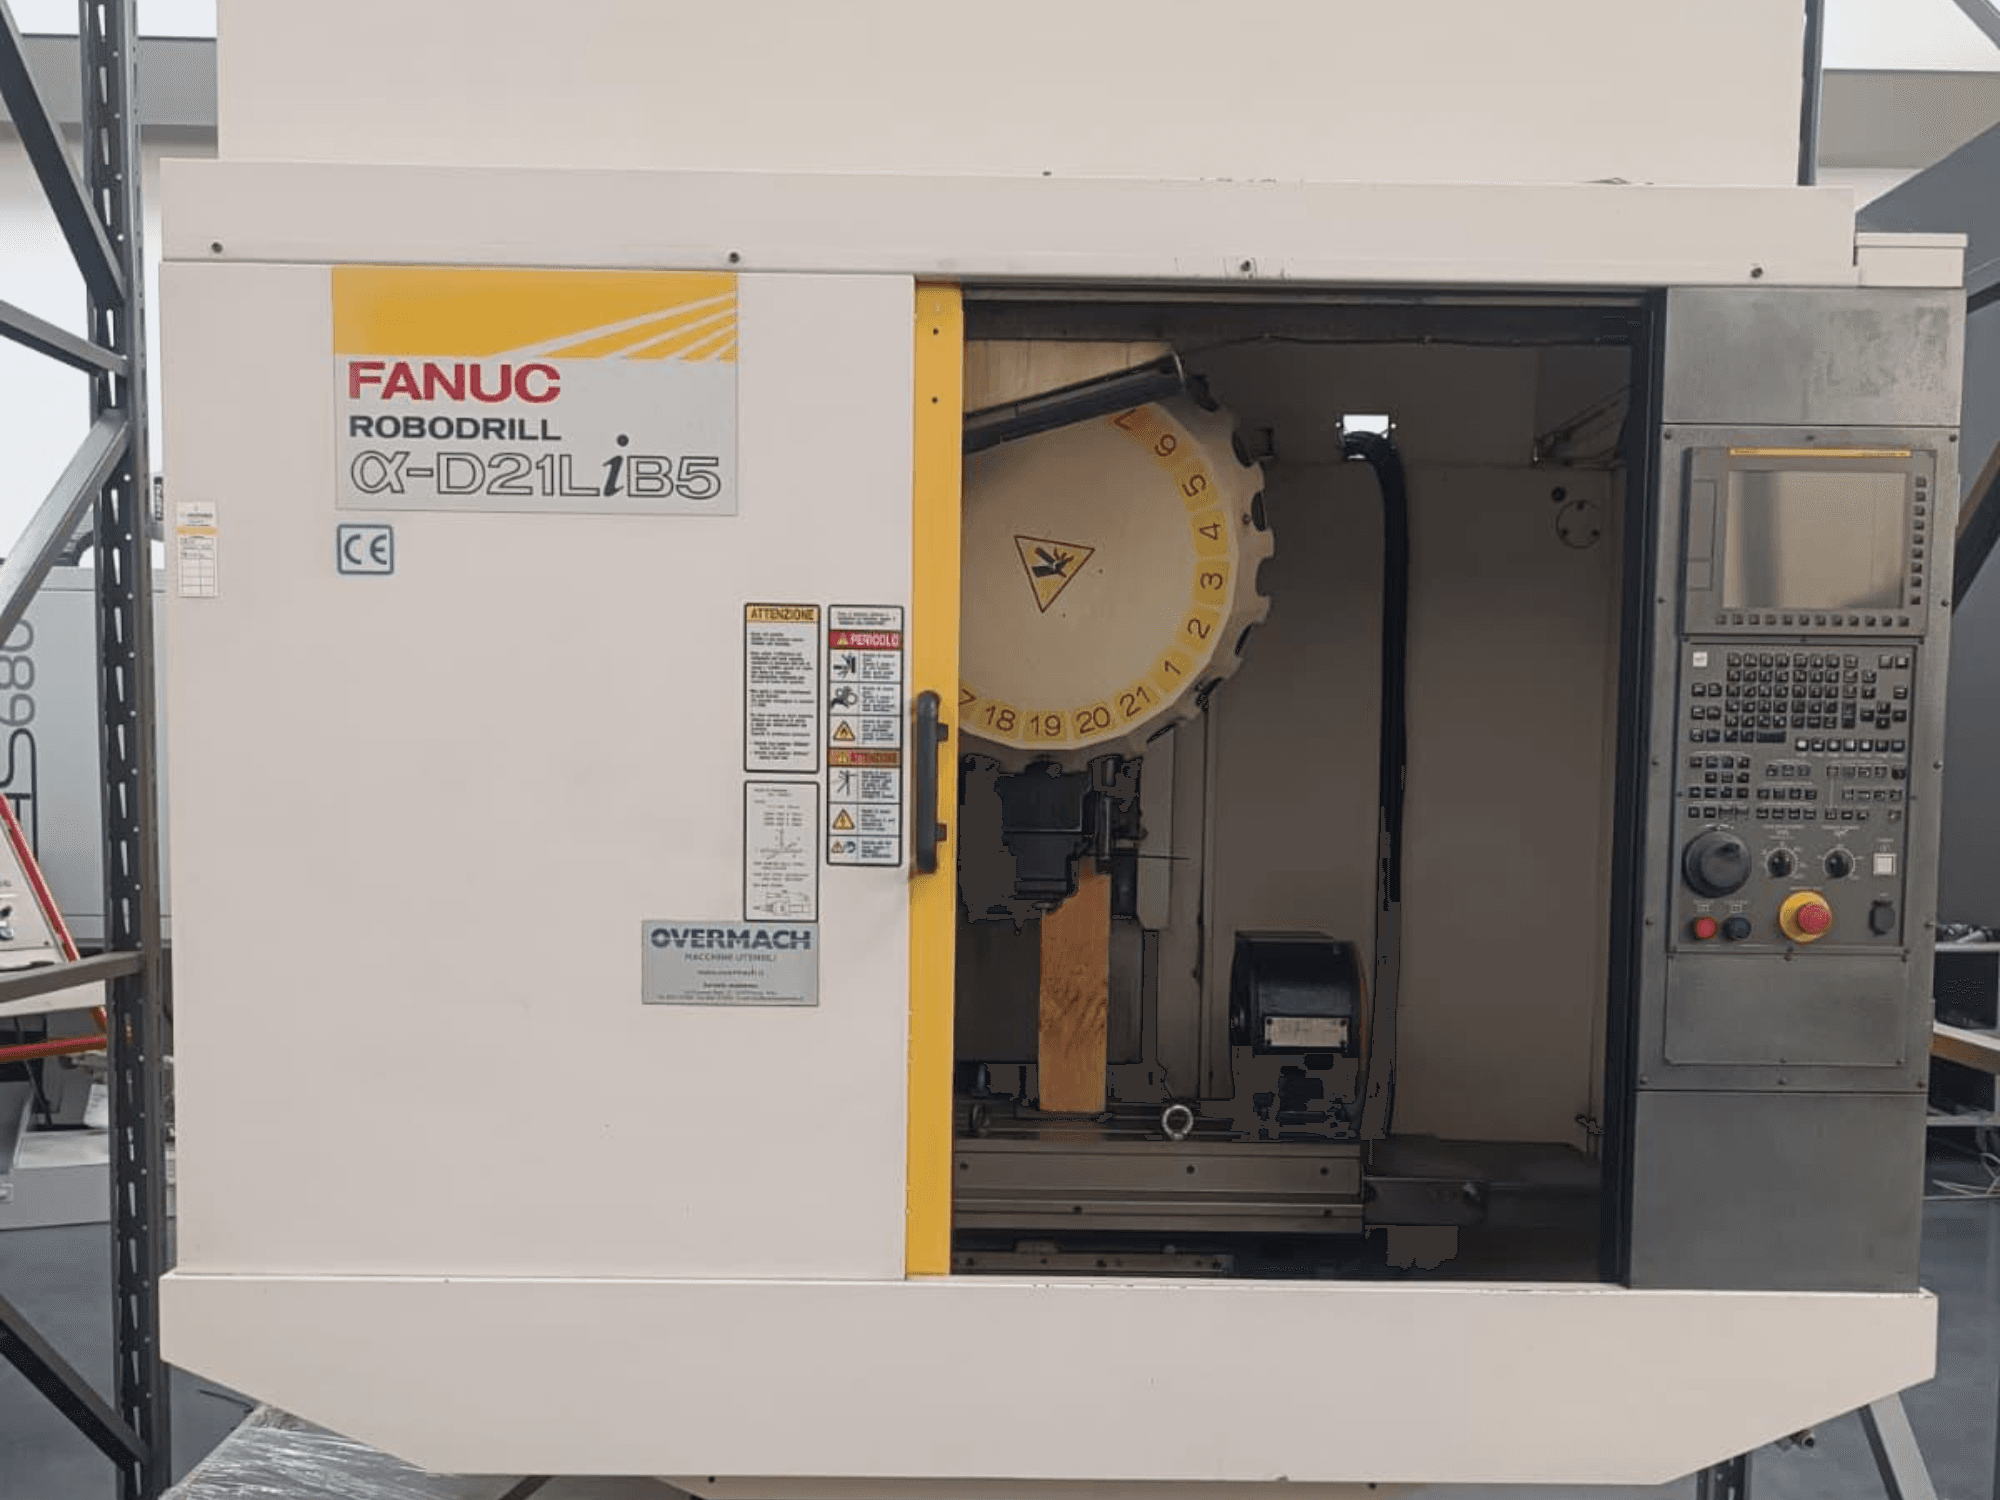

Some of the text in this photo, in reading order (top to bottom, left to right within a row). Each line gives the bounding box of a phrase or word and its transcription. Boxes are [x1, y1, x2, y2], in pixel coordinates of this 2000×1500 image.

[348, 361, 561, 404] FANUC
[349, 415, 561, 441] ROBODRILL
[1182, 474, 1207, 497] 5
[1199, 521, 1222, 541] 4
[1199, 571, 1224, 590] 3
[750, 607, 815, 620] ATTENZIONE
[850, 633, 900, 648] PERICOLO
[1187, 618, 1212, 641] 2
[1163, 659, 1183, 676] 1
[1119, 686, 1152, 716] 21
[985, 705, 1016, 731] 18
[1030, 715, 1062, 737] 19
[1076, 706, 1111, 734] 20
[650, 927, 812, 950] OVERMACH
